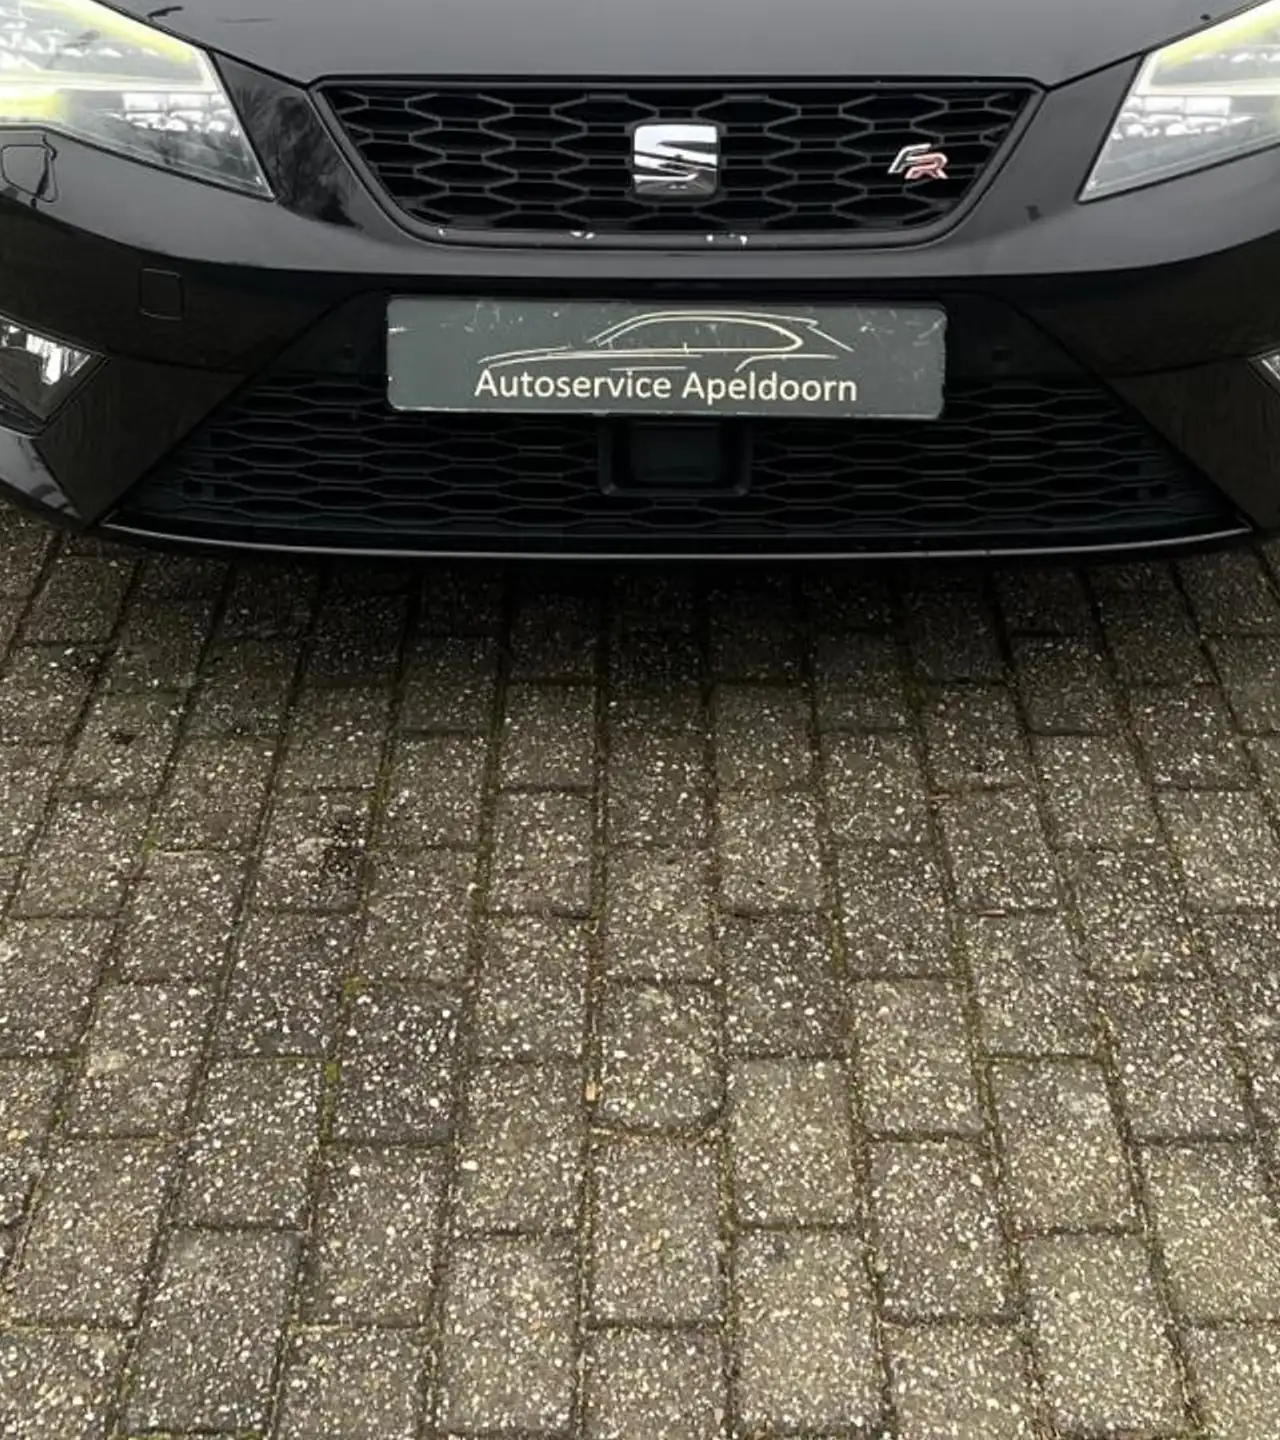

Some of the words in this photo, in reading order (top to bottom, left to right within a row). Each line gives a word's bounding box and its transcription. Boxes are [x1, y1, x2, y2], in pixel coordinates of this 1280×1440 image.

[887, 142, 950, 180] FR
[474, 368, 672, 399] Autoservice
[681, 371, 858, 404] Apeldoorn
